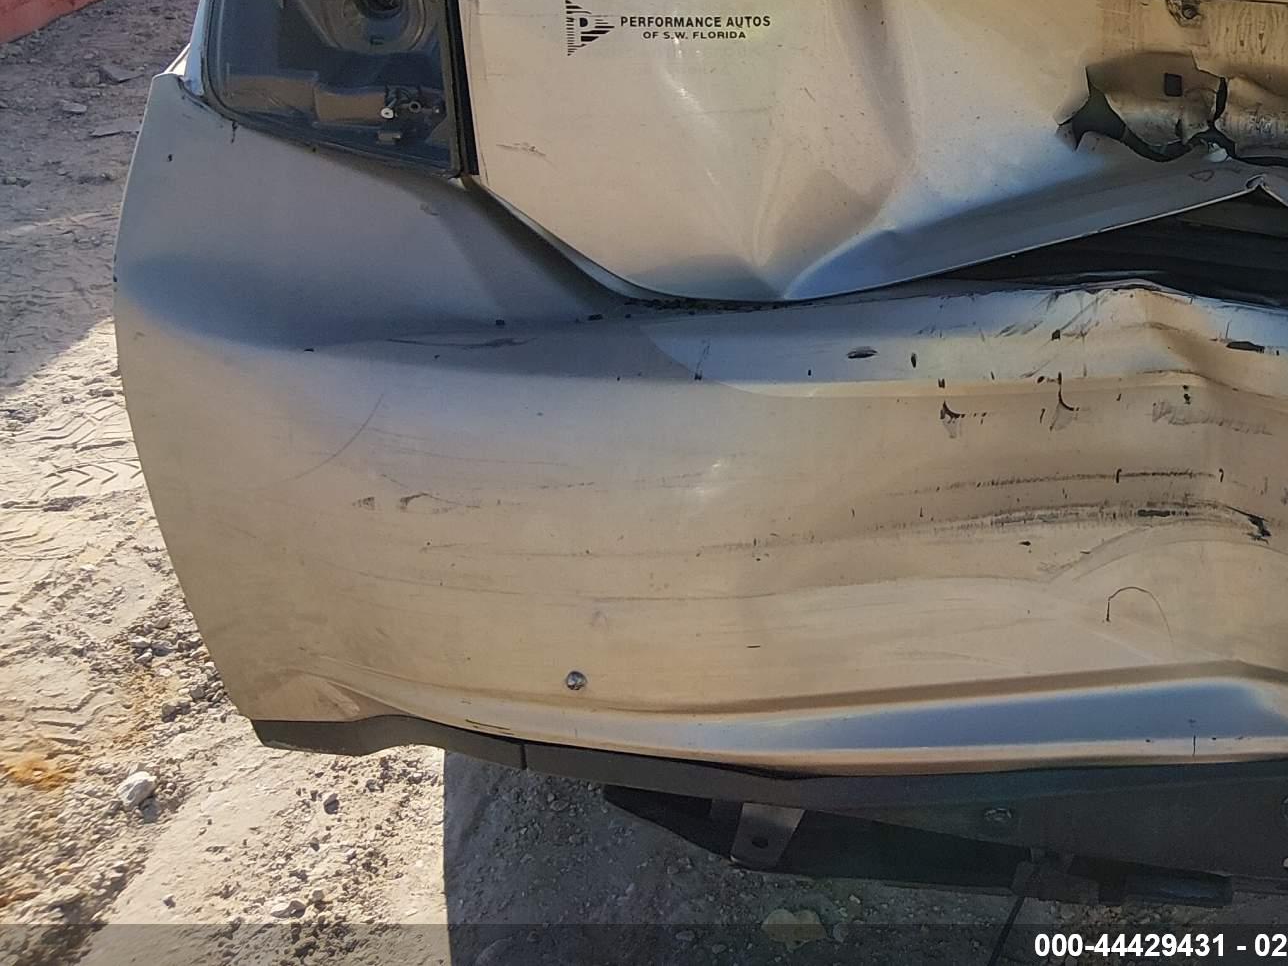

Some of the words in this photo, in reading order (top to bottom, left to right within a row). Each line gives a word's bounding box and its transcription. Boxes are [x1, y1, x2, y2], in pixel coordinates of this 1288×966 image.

[620, 16, 722, 28] PERFORMANCE
[726, 15, 771, 28] AUTOS
[642, 31, 659, 39] OF
[663, 31, 689, 40] S.W.
[692, 31, 747, 40] FLORIDA
